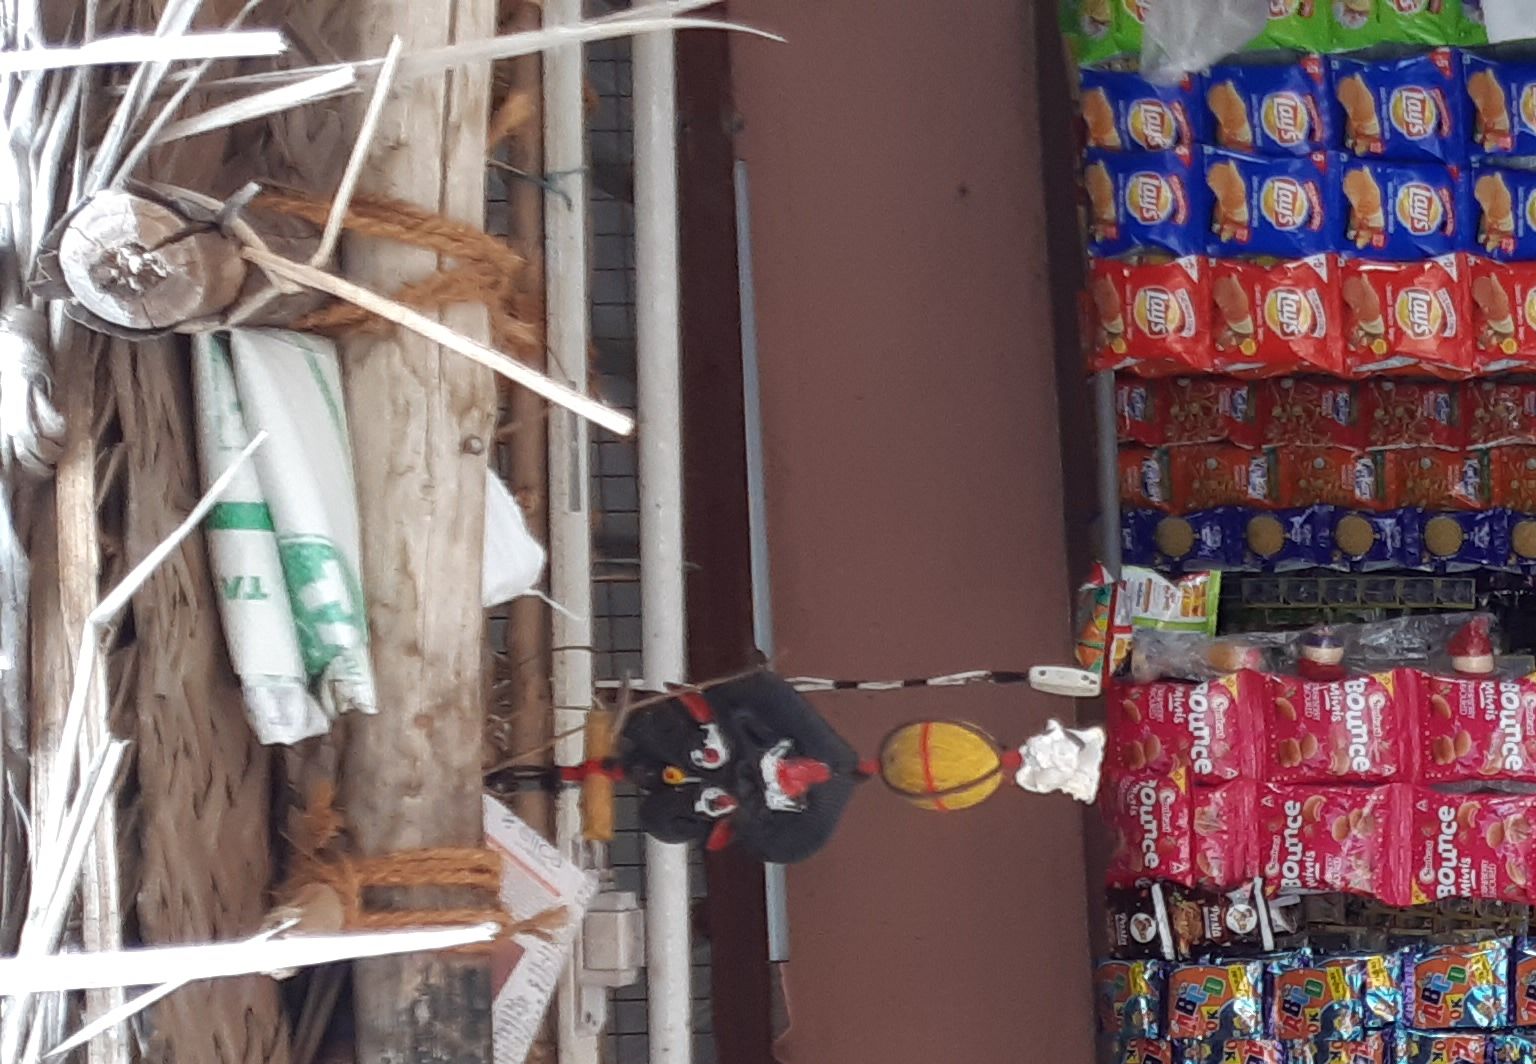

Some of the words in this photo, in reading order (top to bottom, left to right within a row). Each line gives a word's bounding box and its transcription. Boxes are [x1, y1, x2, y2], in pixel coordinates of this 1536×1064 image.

[1142, 101, 1166, 147] Lay's
[1277, 98, 1298, 143] Lay's
[1404, 91, 1429, 138] Lay's
[1137, 174, 1162, 223] Lay's
[1274, 179, 1298, 228] Lay's
[1407, 185, 1433, 230] Lay's
[1143, 290, 1171, 336] Lay's
[1278, 290, 1304, 337] Lay's
[1409, 291, 1436, 339] Lay's
[1500, 682, 1523, 770] Bounce
[1436, 805, 1457, 899] Bounce
